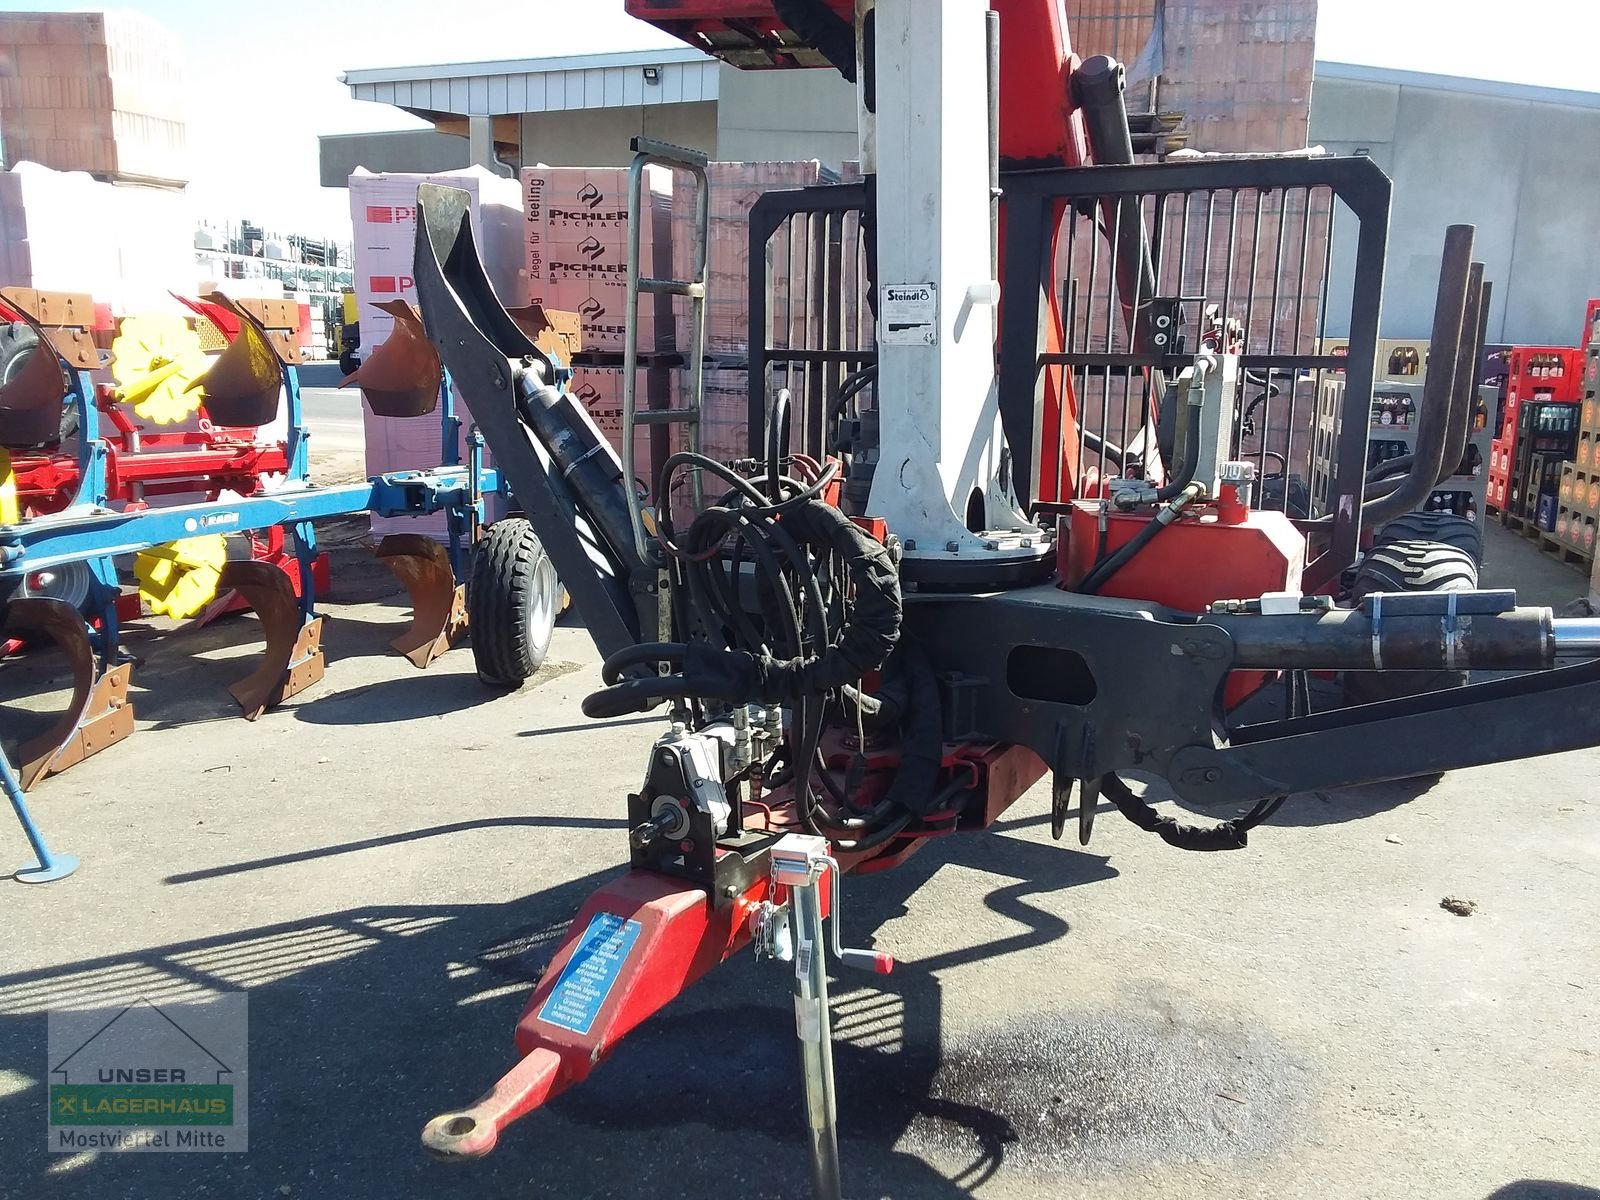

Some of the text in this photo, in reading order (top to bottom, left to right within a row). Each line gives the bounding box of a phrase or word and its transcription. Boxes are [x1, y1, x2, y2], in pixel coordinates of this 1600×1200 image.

[549, 209, 629, 221] PICHLER
[527, 178, 545, 280] Ziegel für feeling
[549, 220, 629, 228] ASCHAC
[549, 272, 620, 280] ASCHAC
[887, 289, 919, 301] Steindl
[581, 324, 627, 334] HLER
